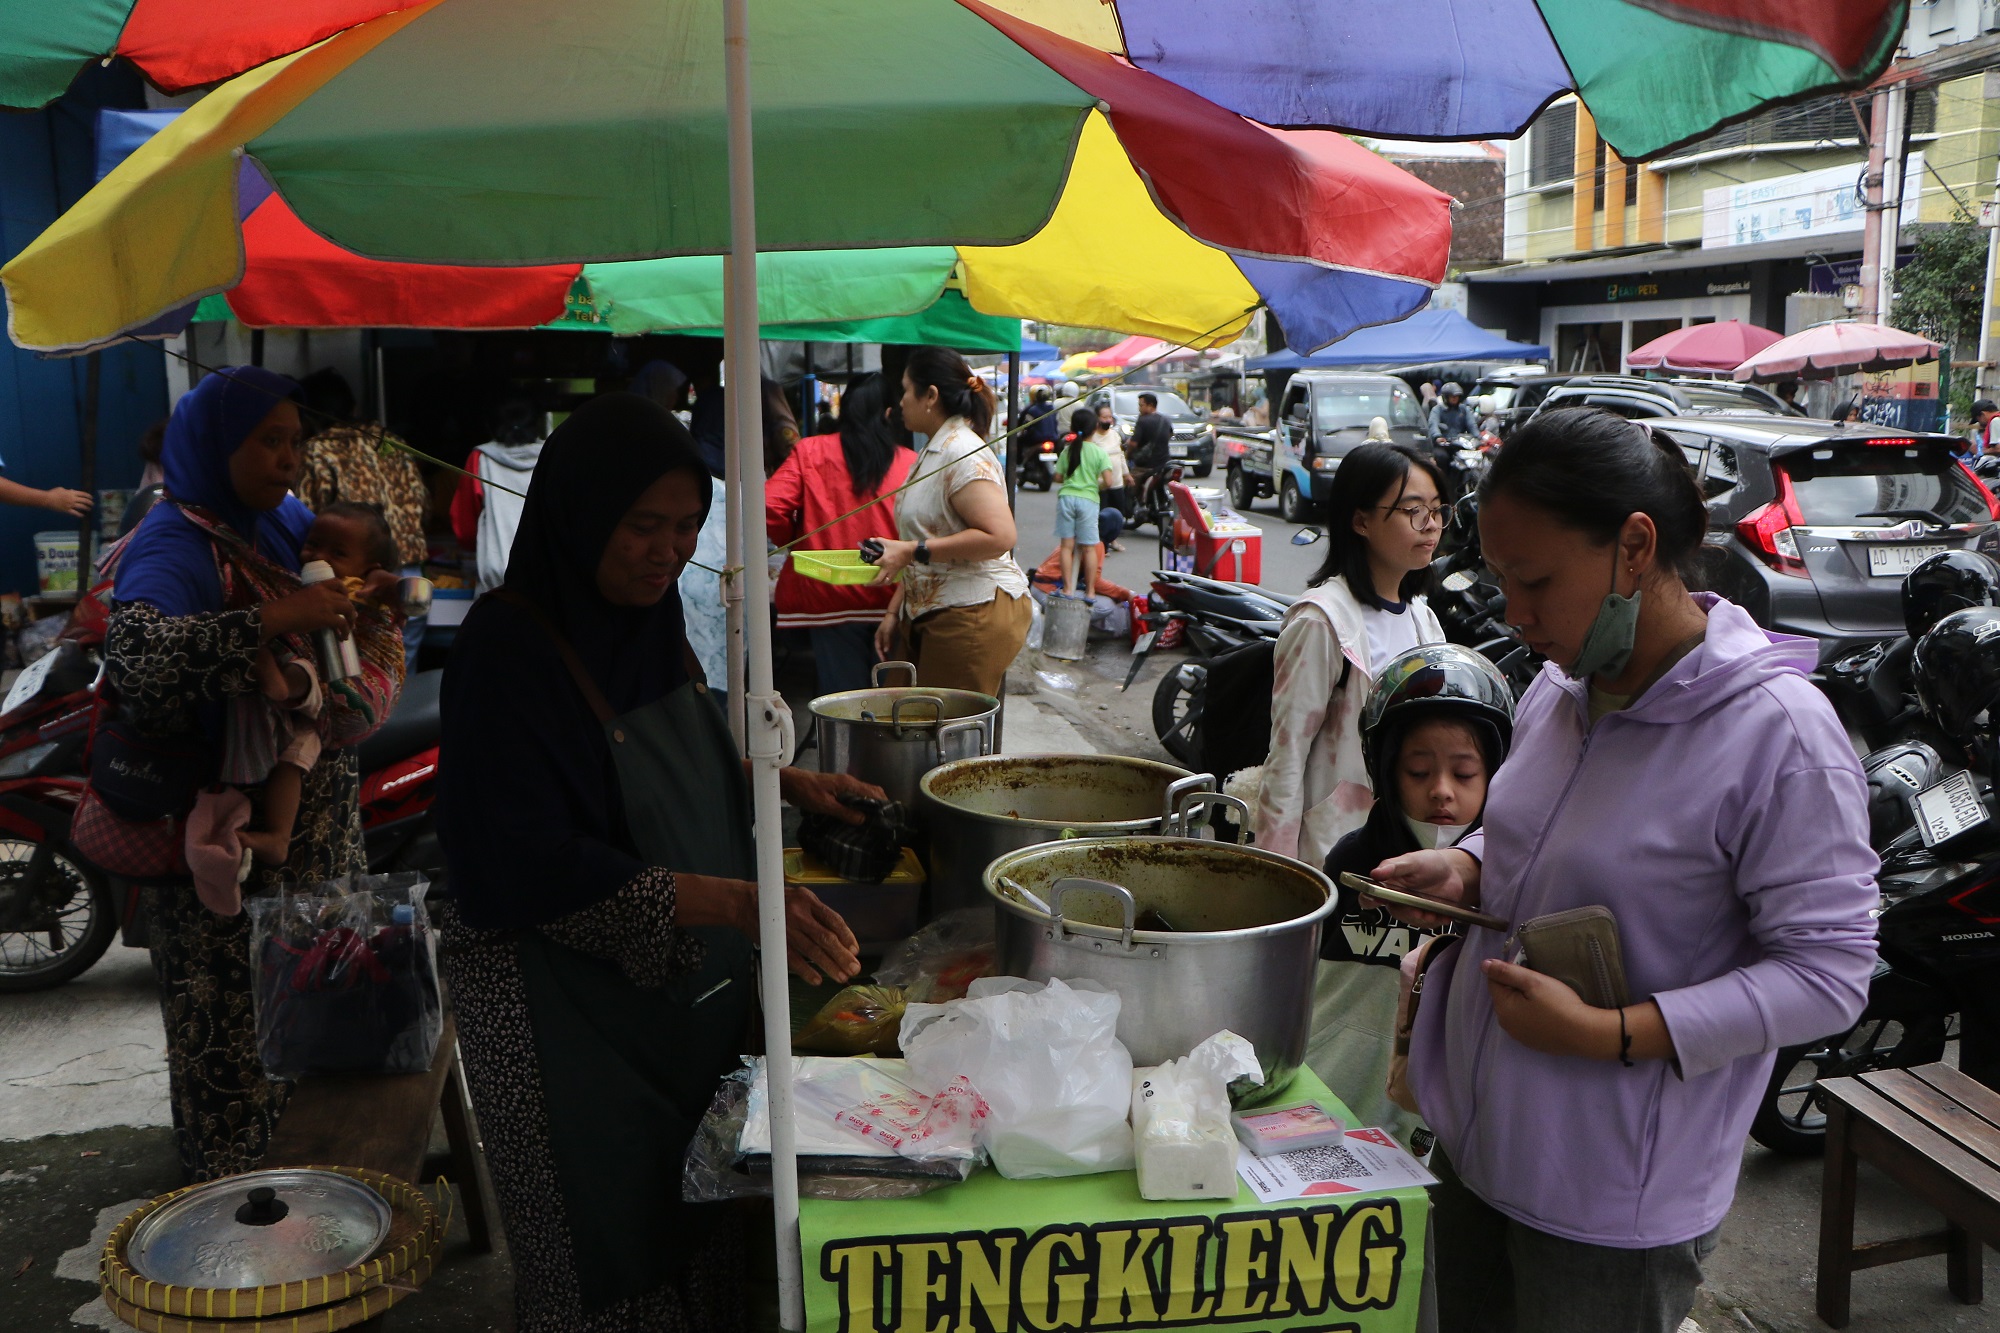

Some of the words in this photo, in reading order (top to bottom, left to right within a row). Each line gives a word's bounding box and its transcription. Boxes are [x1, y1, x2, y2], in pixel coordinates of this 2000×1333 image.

[1618, 284, 1659, 297] EASYPETS
[1806, 545, 1837, 553] JAZZ
[1873, 547, 1888, 566] AD
[1896, 547, 1925, 564] 1419
[381, 763, 435, 791] MIO
[1889, 766, 1918, 787] INK
[1941, 775, 1965, 794] AD
[1946, 785, 1975, 814] 4654
[1954, 804, 1981, 830] EAA
[1941, 931, 1996, 942] HONDA
[824, 1202, 1403, 1333] TENGKLENG
